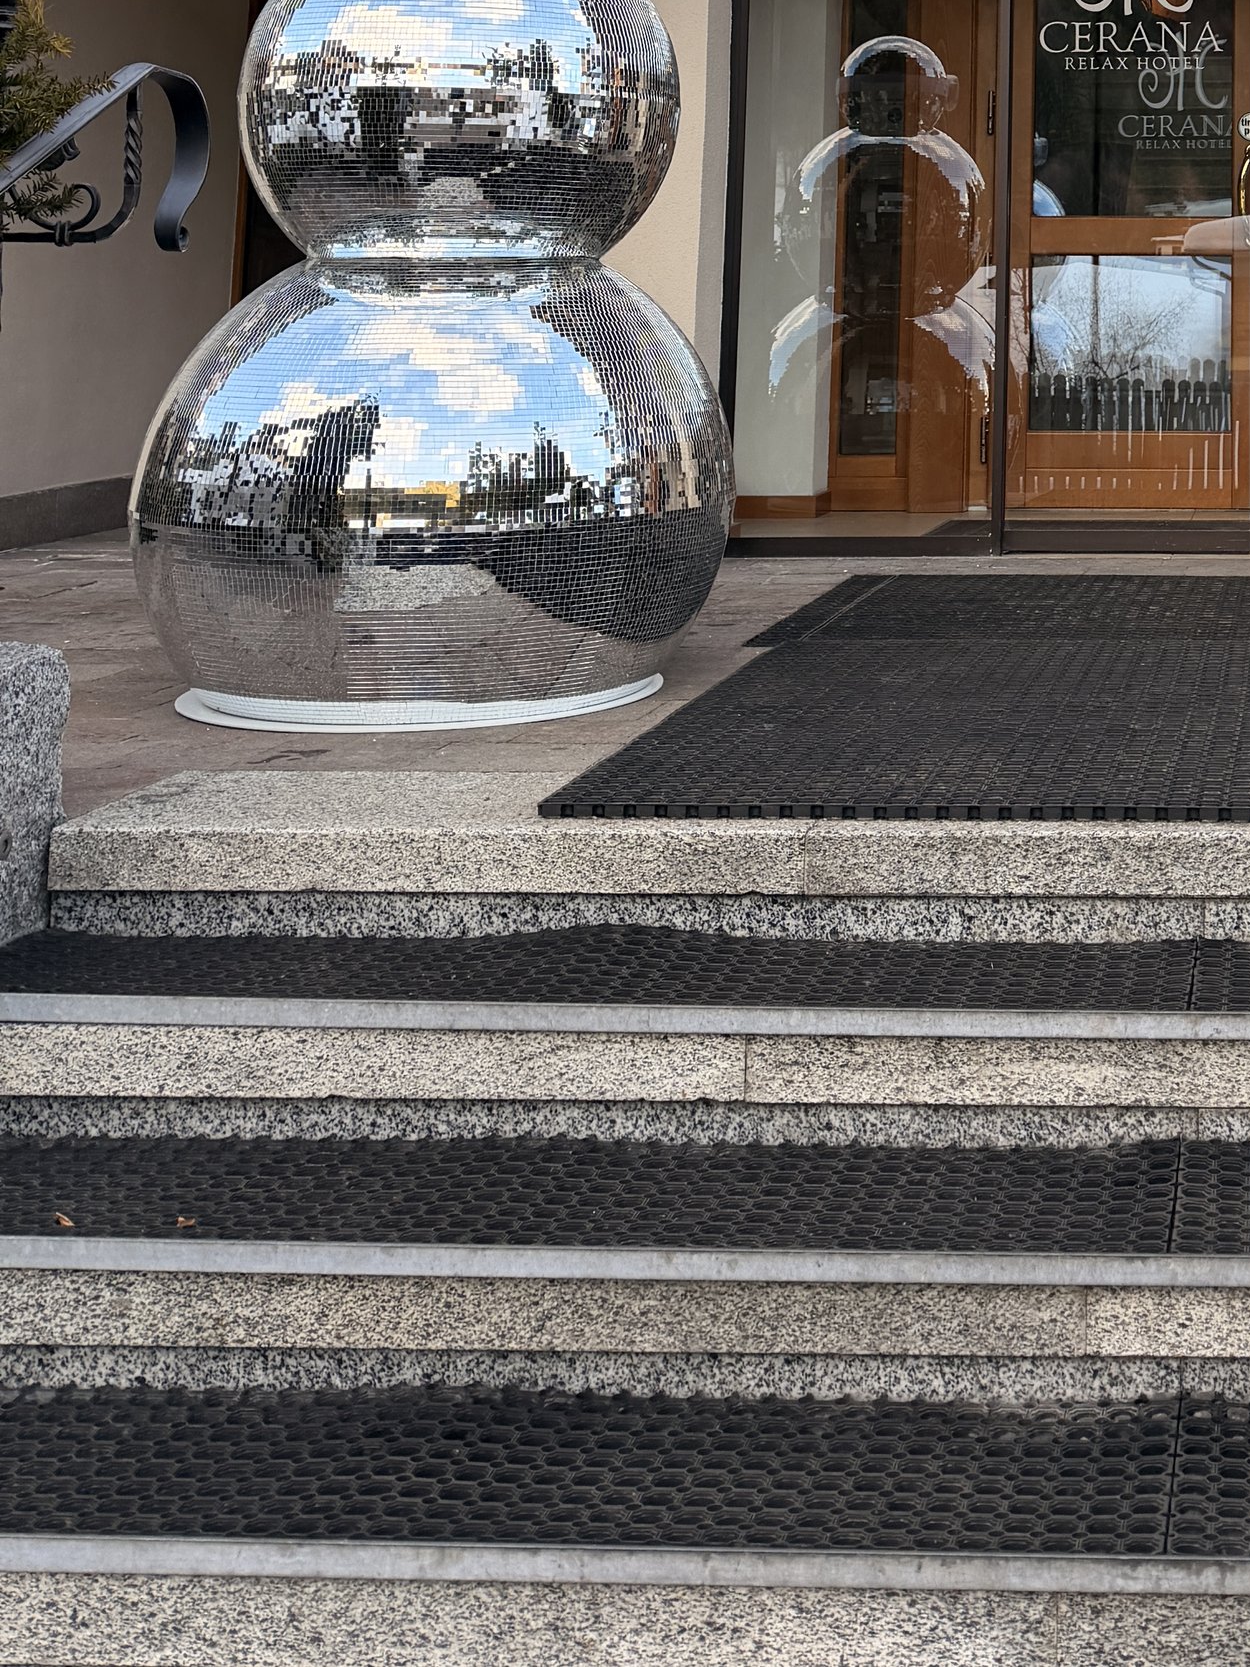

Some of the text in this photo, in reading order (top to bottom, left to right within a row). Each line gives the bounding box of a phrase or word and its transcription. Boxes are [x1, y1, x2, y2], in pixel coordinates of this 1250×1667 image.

[1039, 20, 1224, 53] CERANA
[1064, 56, 1206, 70] RELAX HOTEL
[1136, 139, 1181, 150] RELAX
